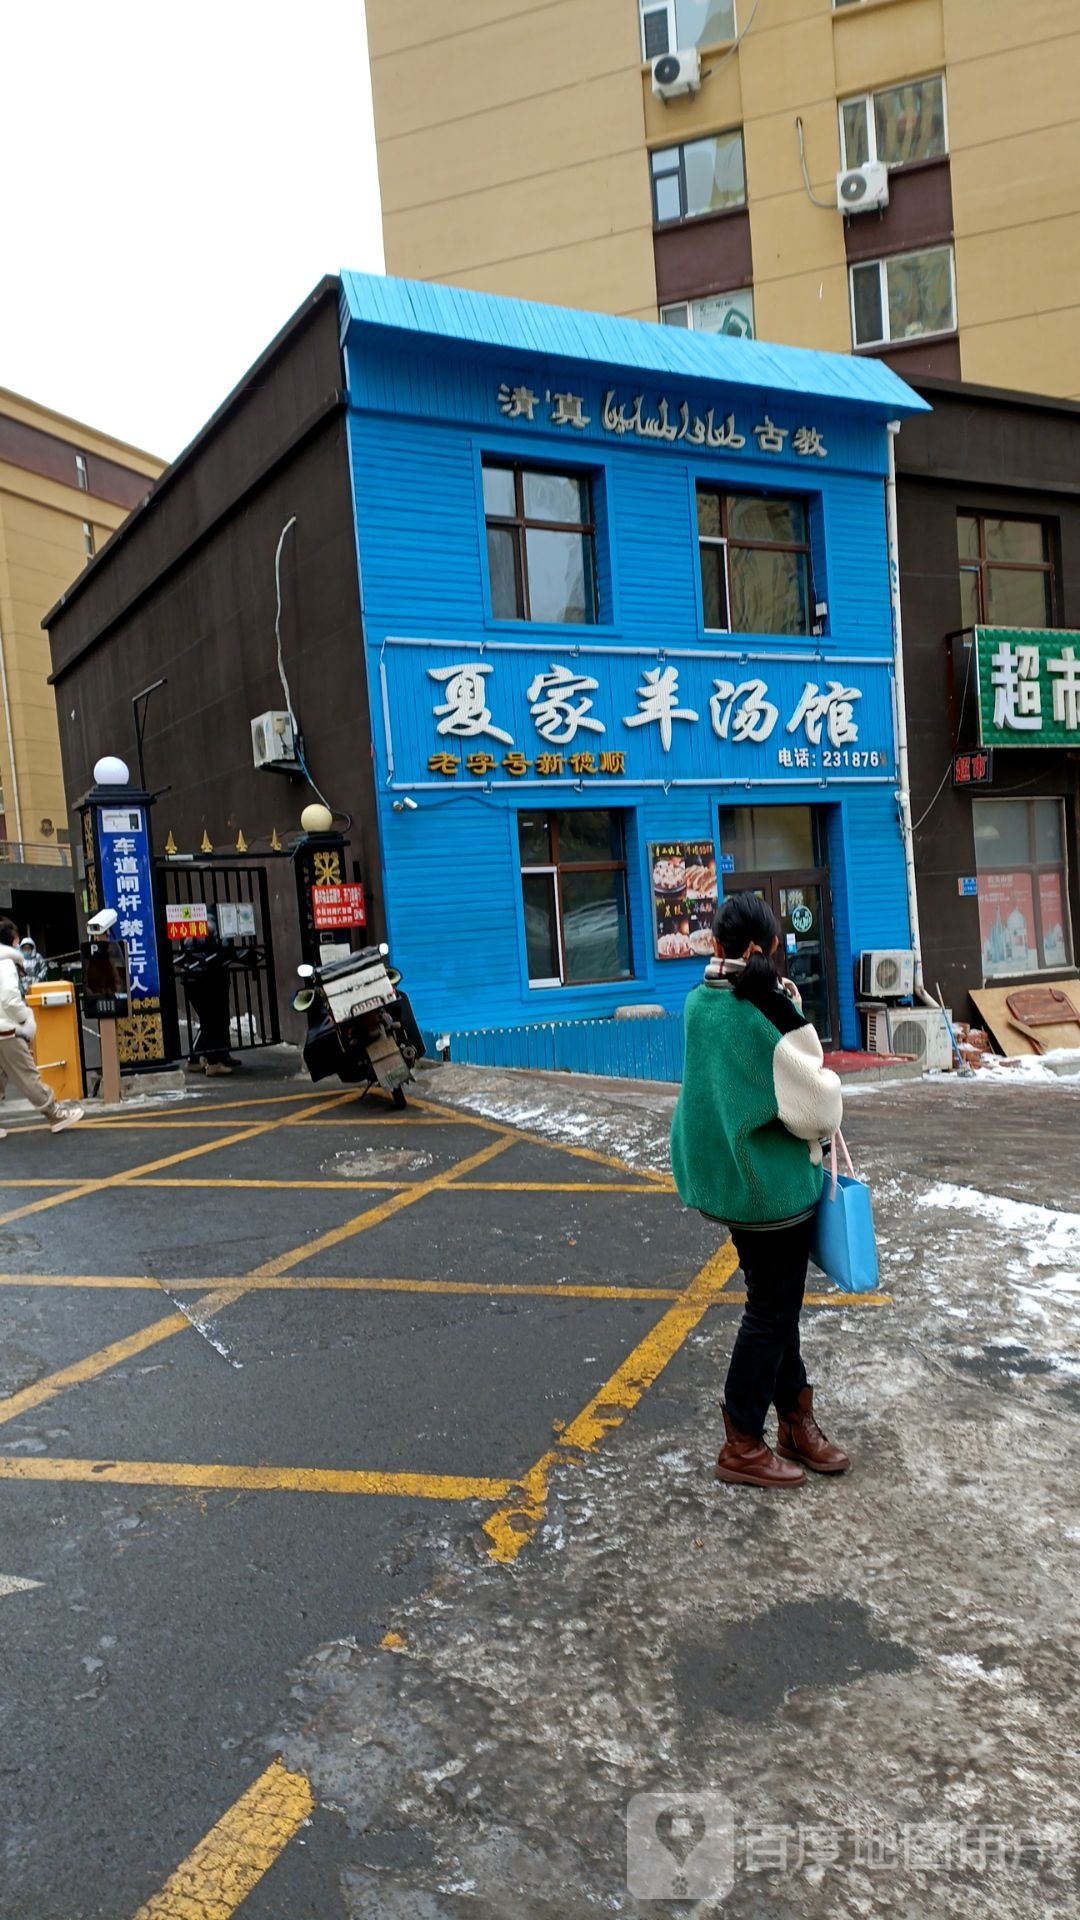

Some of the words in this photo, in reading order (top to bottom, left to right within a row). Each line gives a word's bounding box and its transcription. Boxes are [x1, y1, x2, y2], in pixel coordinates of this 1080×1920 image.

[497, 383, 591, 429] 清真
[754, 414, 828, 457] 古教
[426, 662, 863, 753] 夏家羊汤馆
[991, 641, 1080, 731] 超市
[429, 751, 627, 775] 老字号新德顺
[955, 753, 988, 782] 超市
